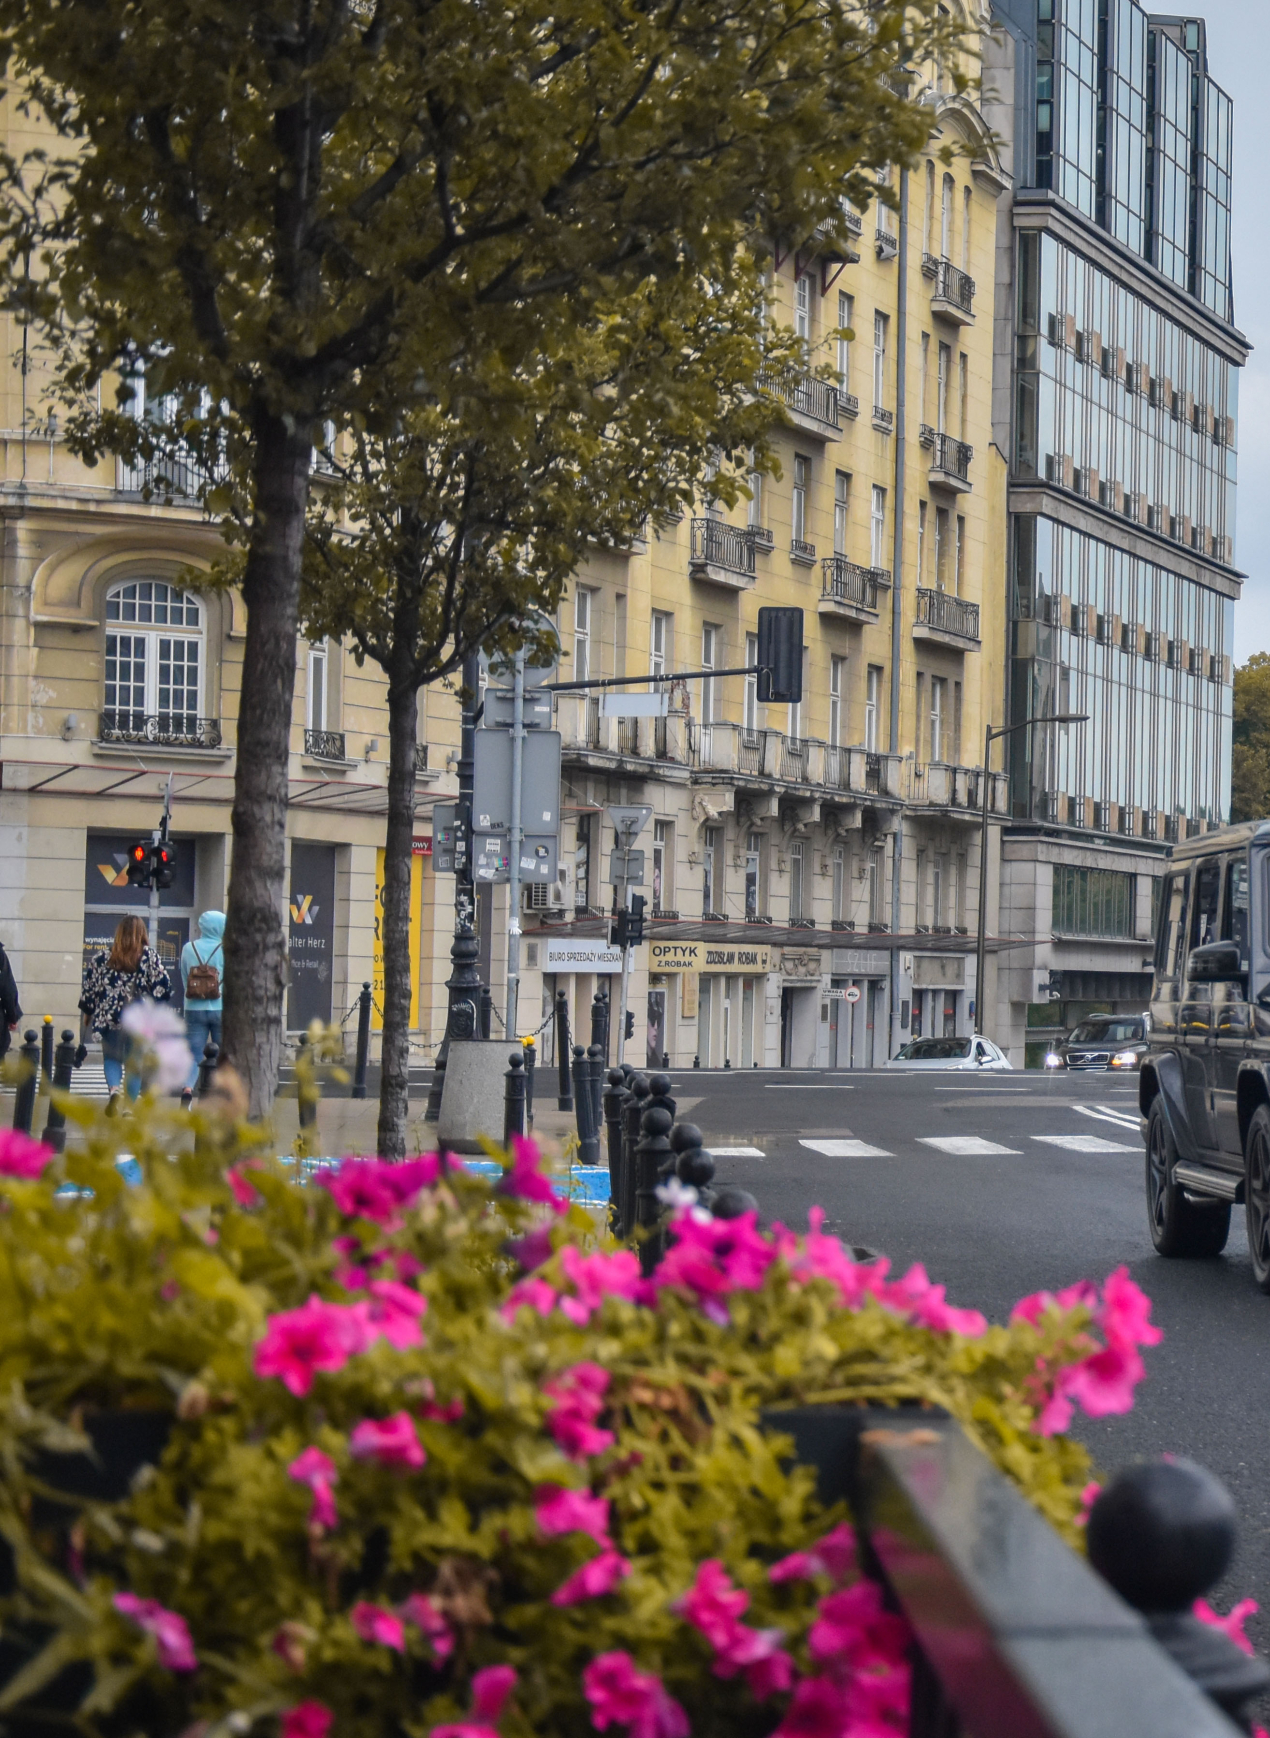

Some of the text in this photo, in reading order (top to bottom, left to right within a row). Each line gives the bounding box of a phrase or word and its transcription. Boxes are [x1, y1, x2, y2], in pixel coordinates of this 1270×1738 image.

[288, 935, 326, 948] alter Herz
[548, 951, 566, 962] BIURO
[566, 949, 597, 963] SPRZEDAŻY
[652, 945, 698, 958] OPTYK
[705, 950, 759, 966] ZDZISŁAW ROBAK
[656, 960, 694, 968] Z.ROBAK
